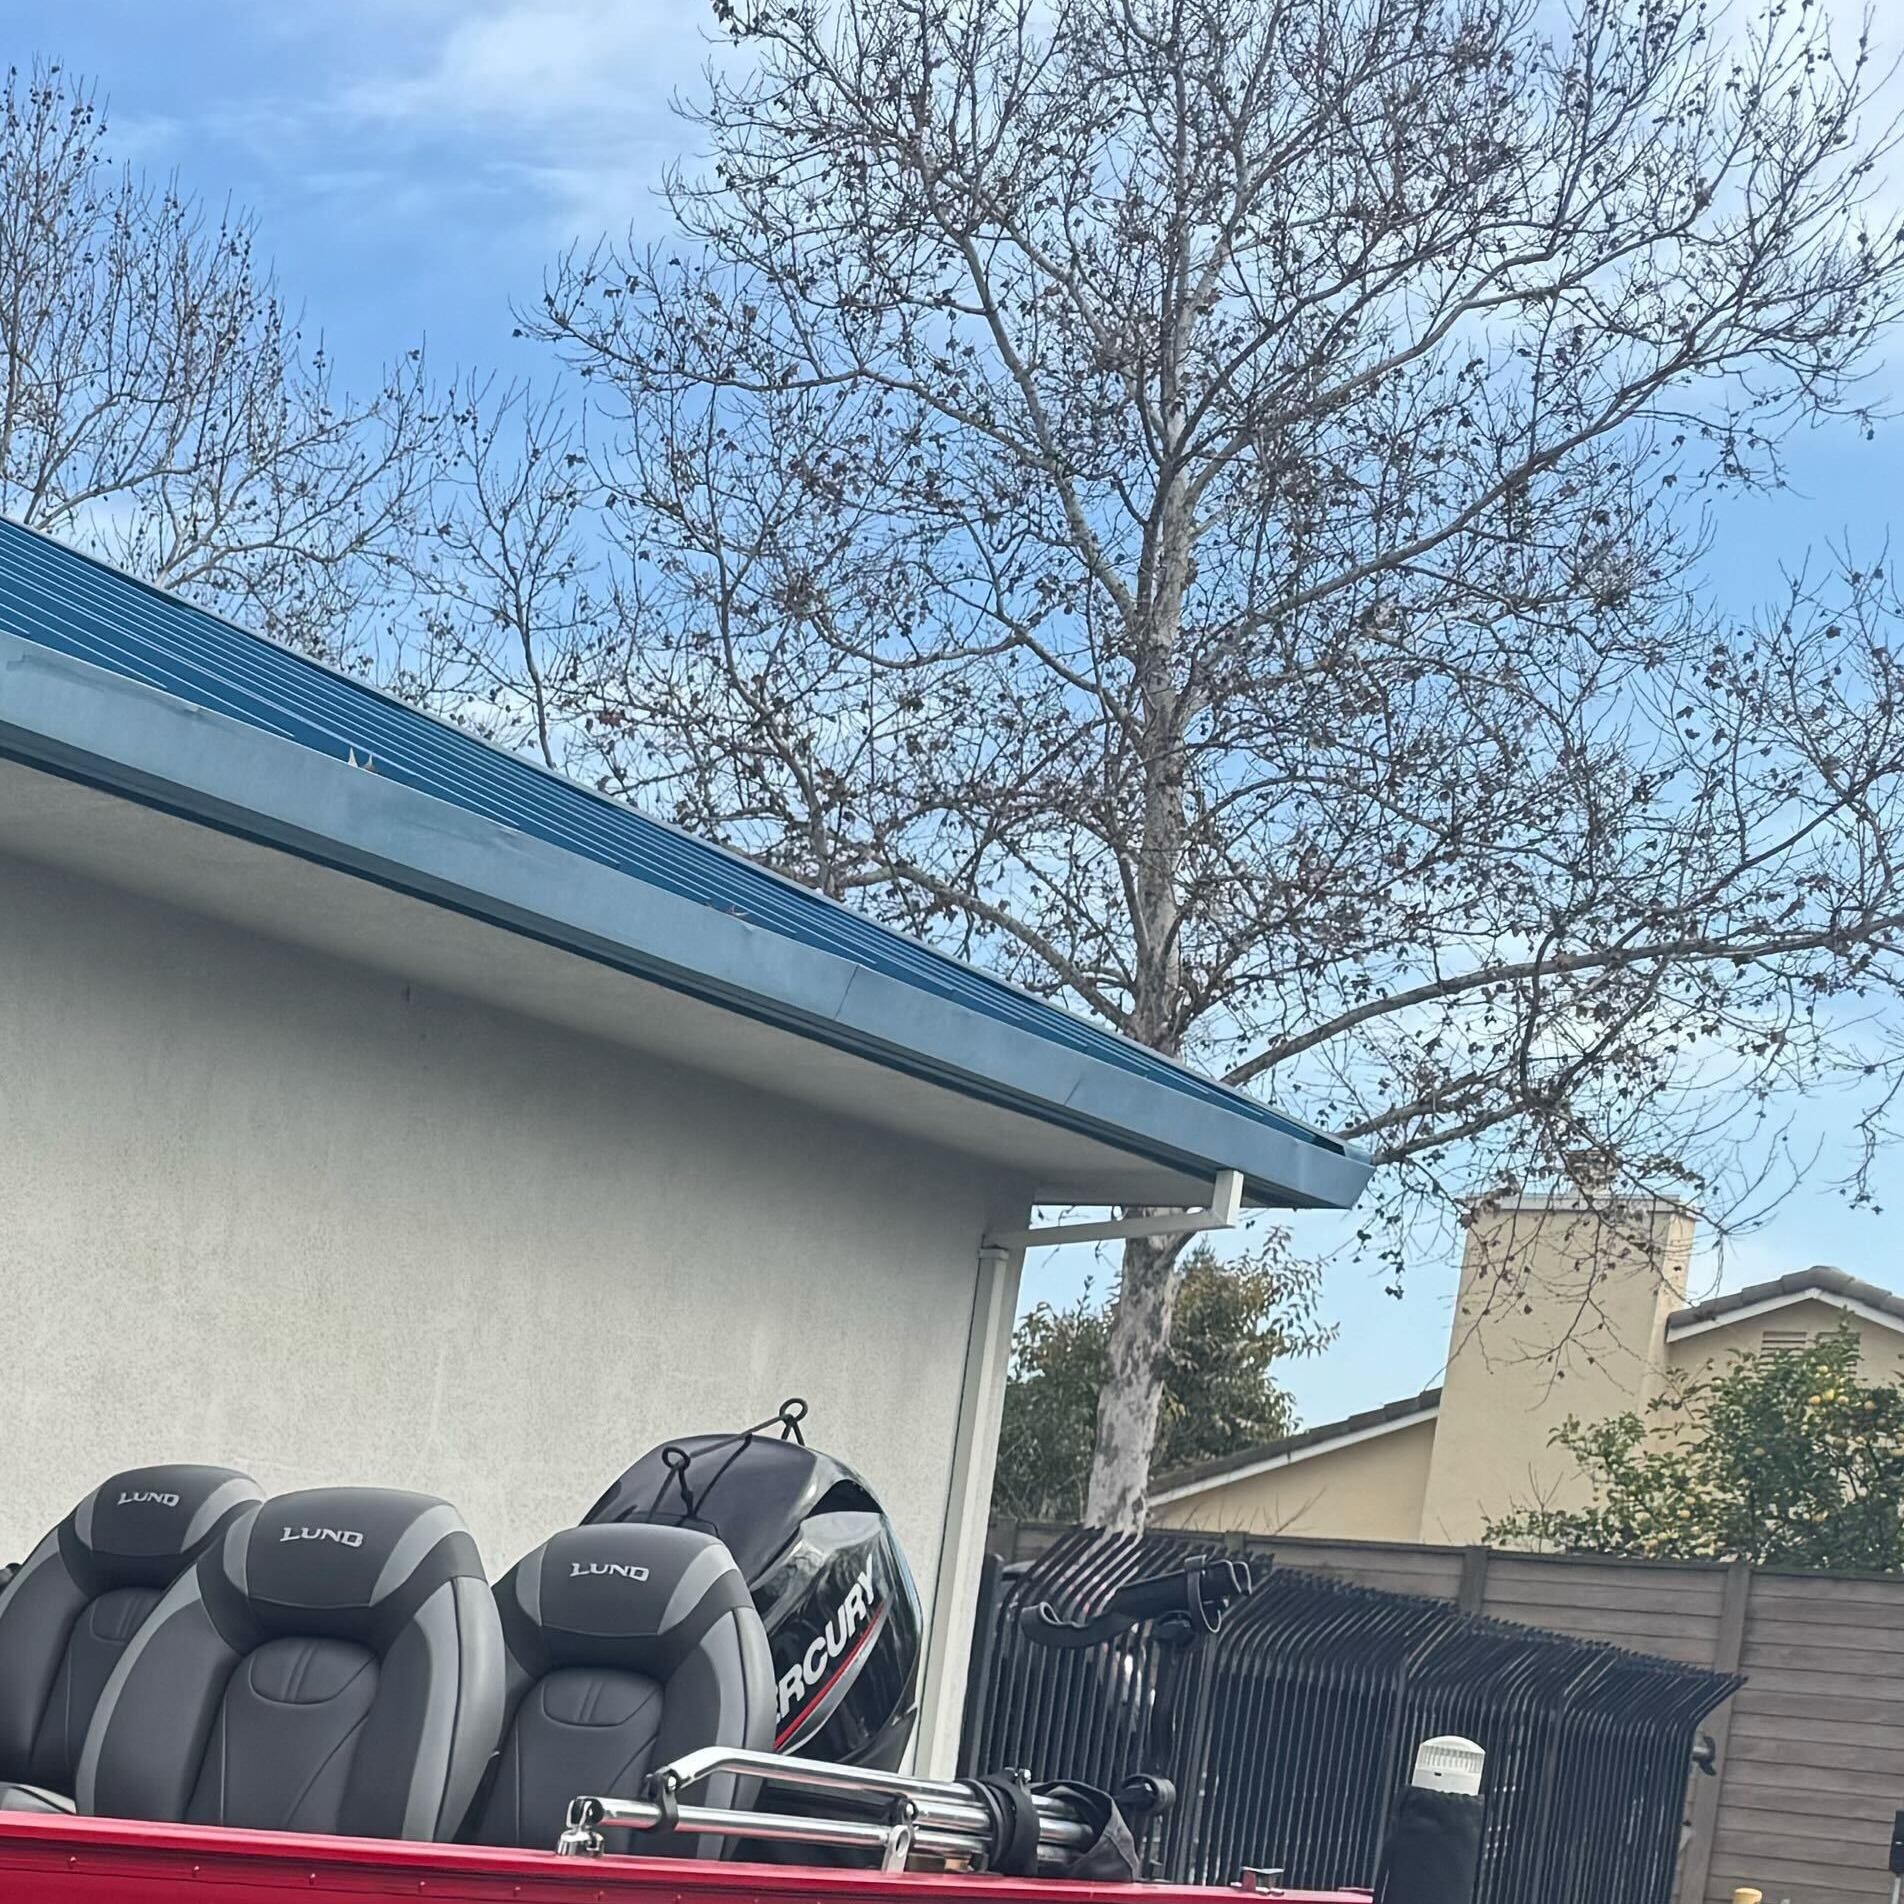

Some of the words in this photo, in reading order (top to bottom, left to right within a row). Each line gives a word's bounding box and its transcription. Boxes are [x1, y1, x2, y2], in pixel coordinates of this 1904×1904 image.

[117, 1490, 181, 1508] LUND
[279, 1526, 364, 1549] LUND
[569, 1561, 650, 1583] LUND
[776, 1553, 874, 1724] RCURY
